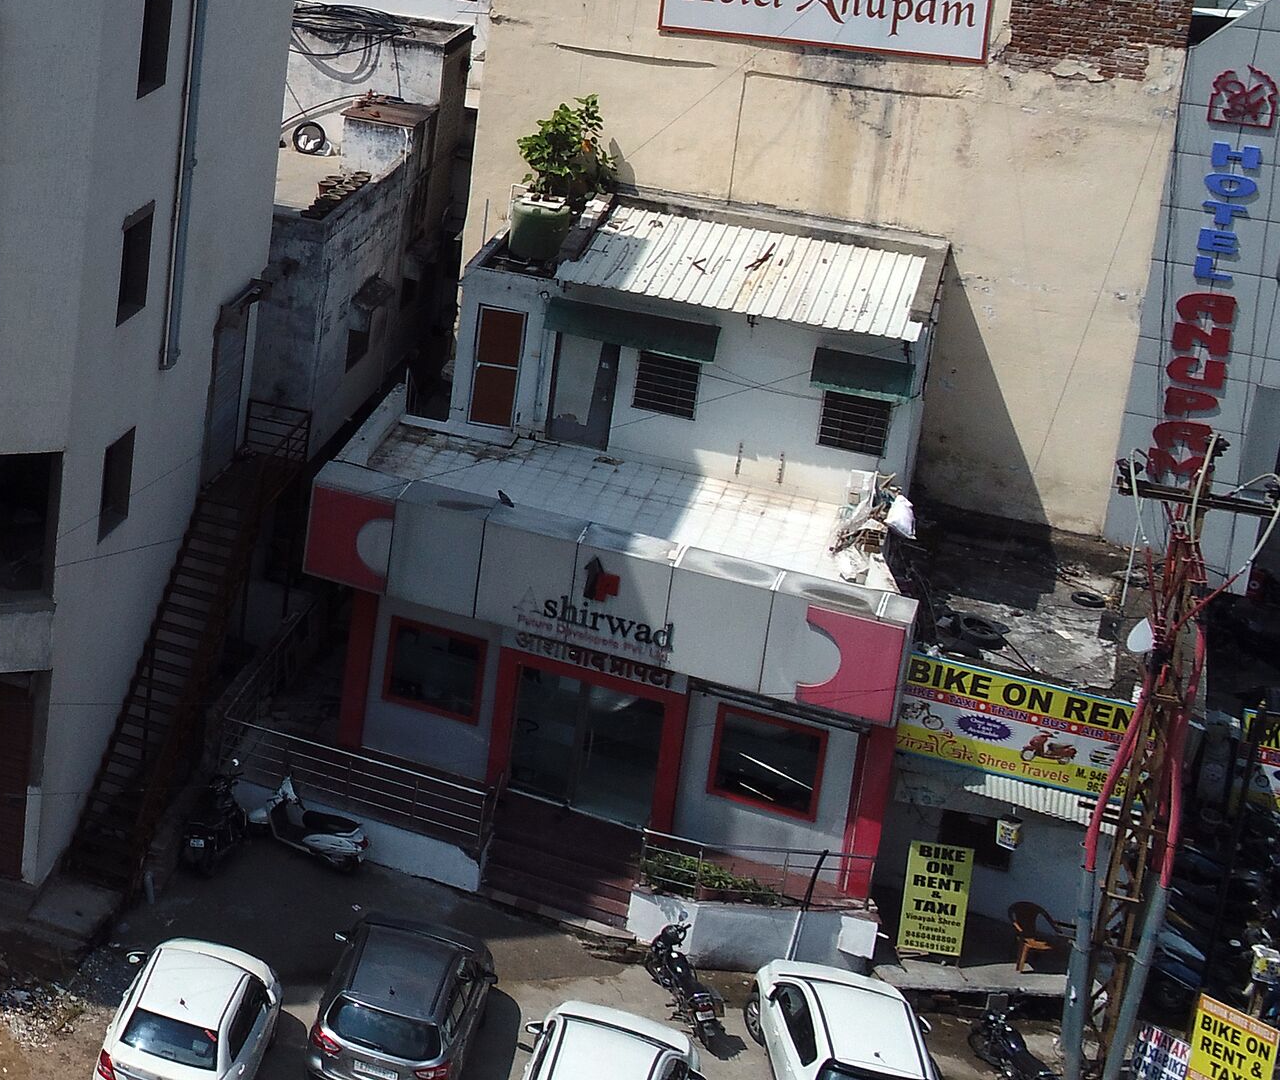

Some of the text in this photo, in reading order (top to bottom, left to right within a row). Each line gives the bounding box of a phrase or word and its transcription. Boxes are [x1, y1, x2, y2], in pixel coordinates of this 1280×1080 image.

[1193, 141, 1261, 281] HOTEL
[907, 658, 1138, 733] BIKE ON REN
[904, 684, 936, 699] BIKE
[948, 694, 977, 710] TAXI
[989, 704, 1029, 721] TRAIN
[1042, 717, 1069, 730] BUS
[1080, 726, 1105, 739] AIR
[977, 752, 1017, 772] Shree
[1021, 762, 1071, 784] Travels
[919, 844, 966, 863] BIKE
[926, 861, 955, 877] ON
[913, 874, 965, 893] RENT
[930, 890, 942, 899] &
[913, 898, 958, 917] TAXI
[1200, 1014, 1242, 1047] BIKE
[1246, 1037, 1271, 1061] ON
[1162, 1054, 1187, 1078] BIKE
[1200, 1036, 1263, 1079] RENT &
[1210, 1061, 1251, 1080] TA
